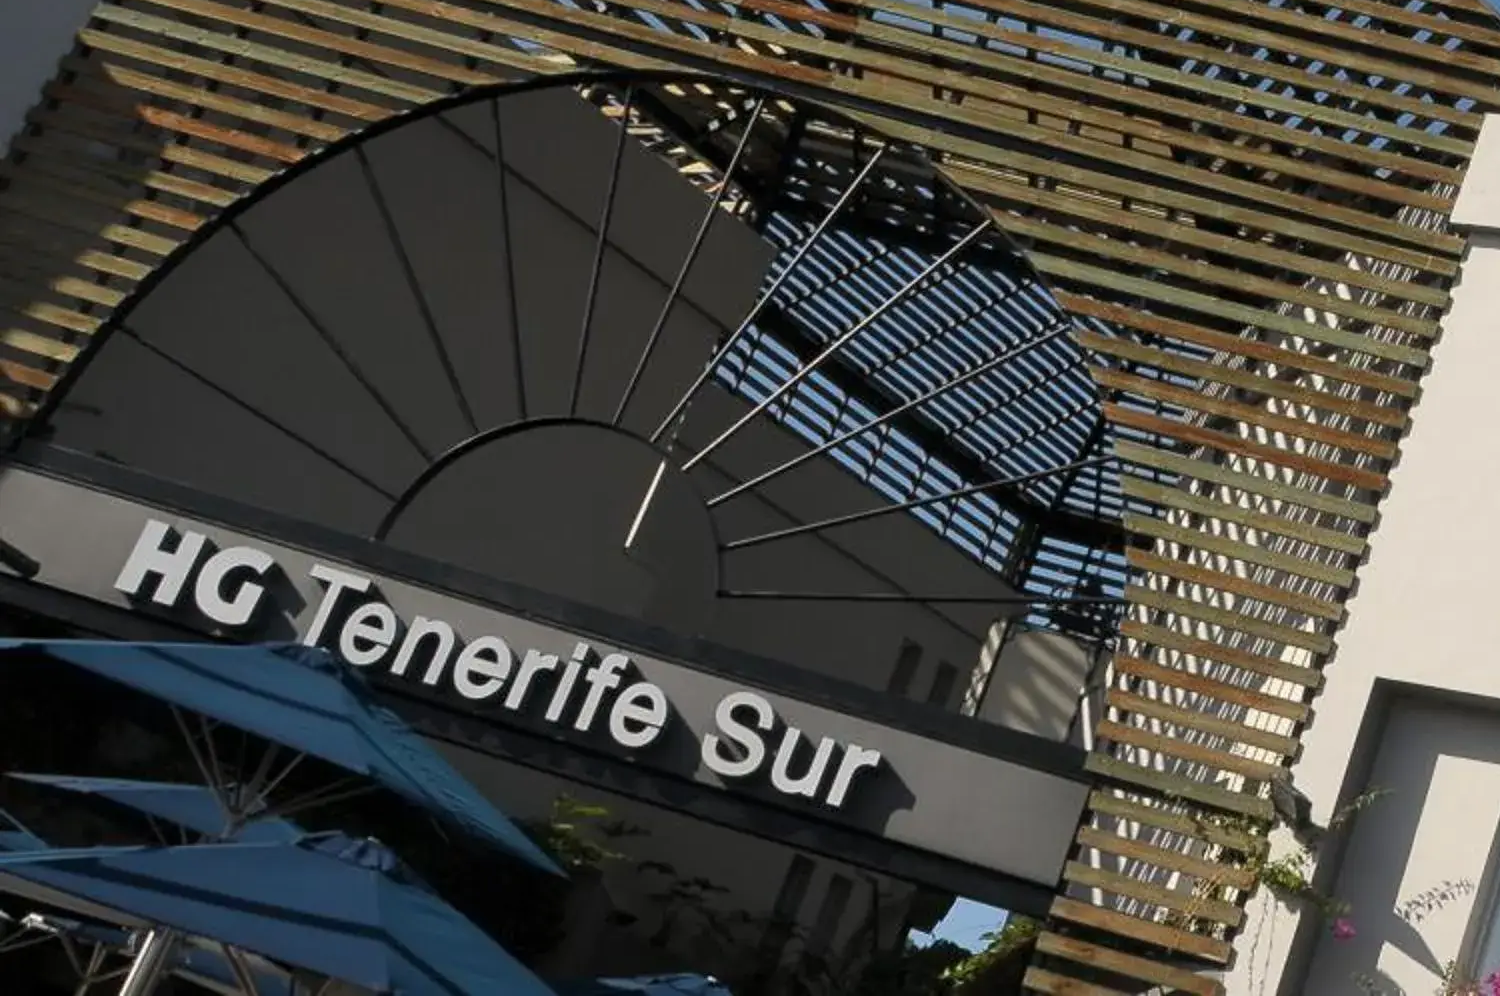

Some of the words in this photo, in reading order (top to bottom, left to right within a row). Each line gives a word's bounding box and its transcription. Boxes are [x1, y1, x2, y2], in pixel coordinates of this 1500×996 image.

[113, 519, 276, 625] HG
[302, 564, 668, 748] Tenerife
[702, 692, 881, 806] Sur
